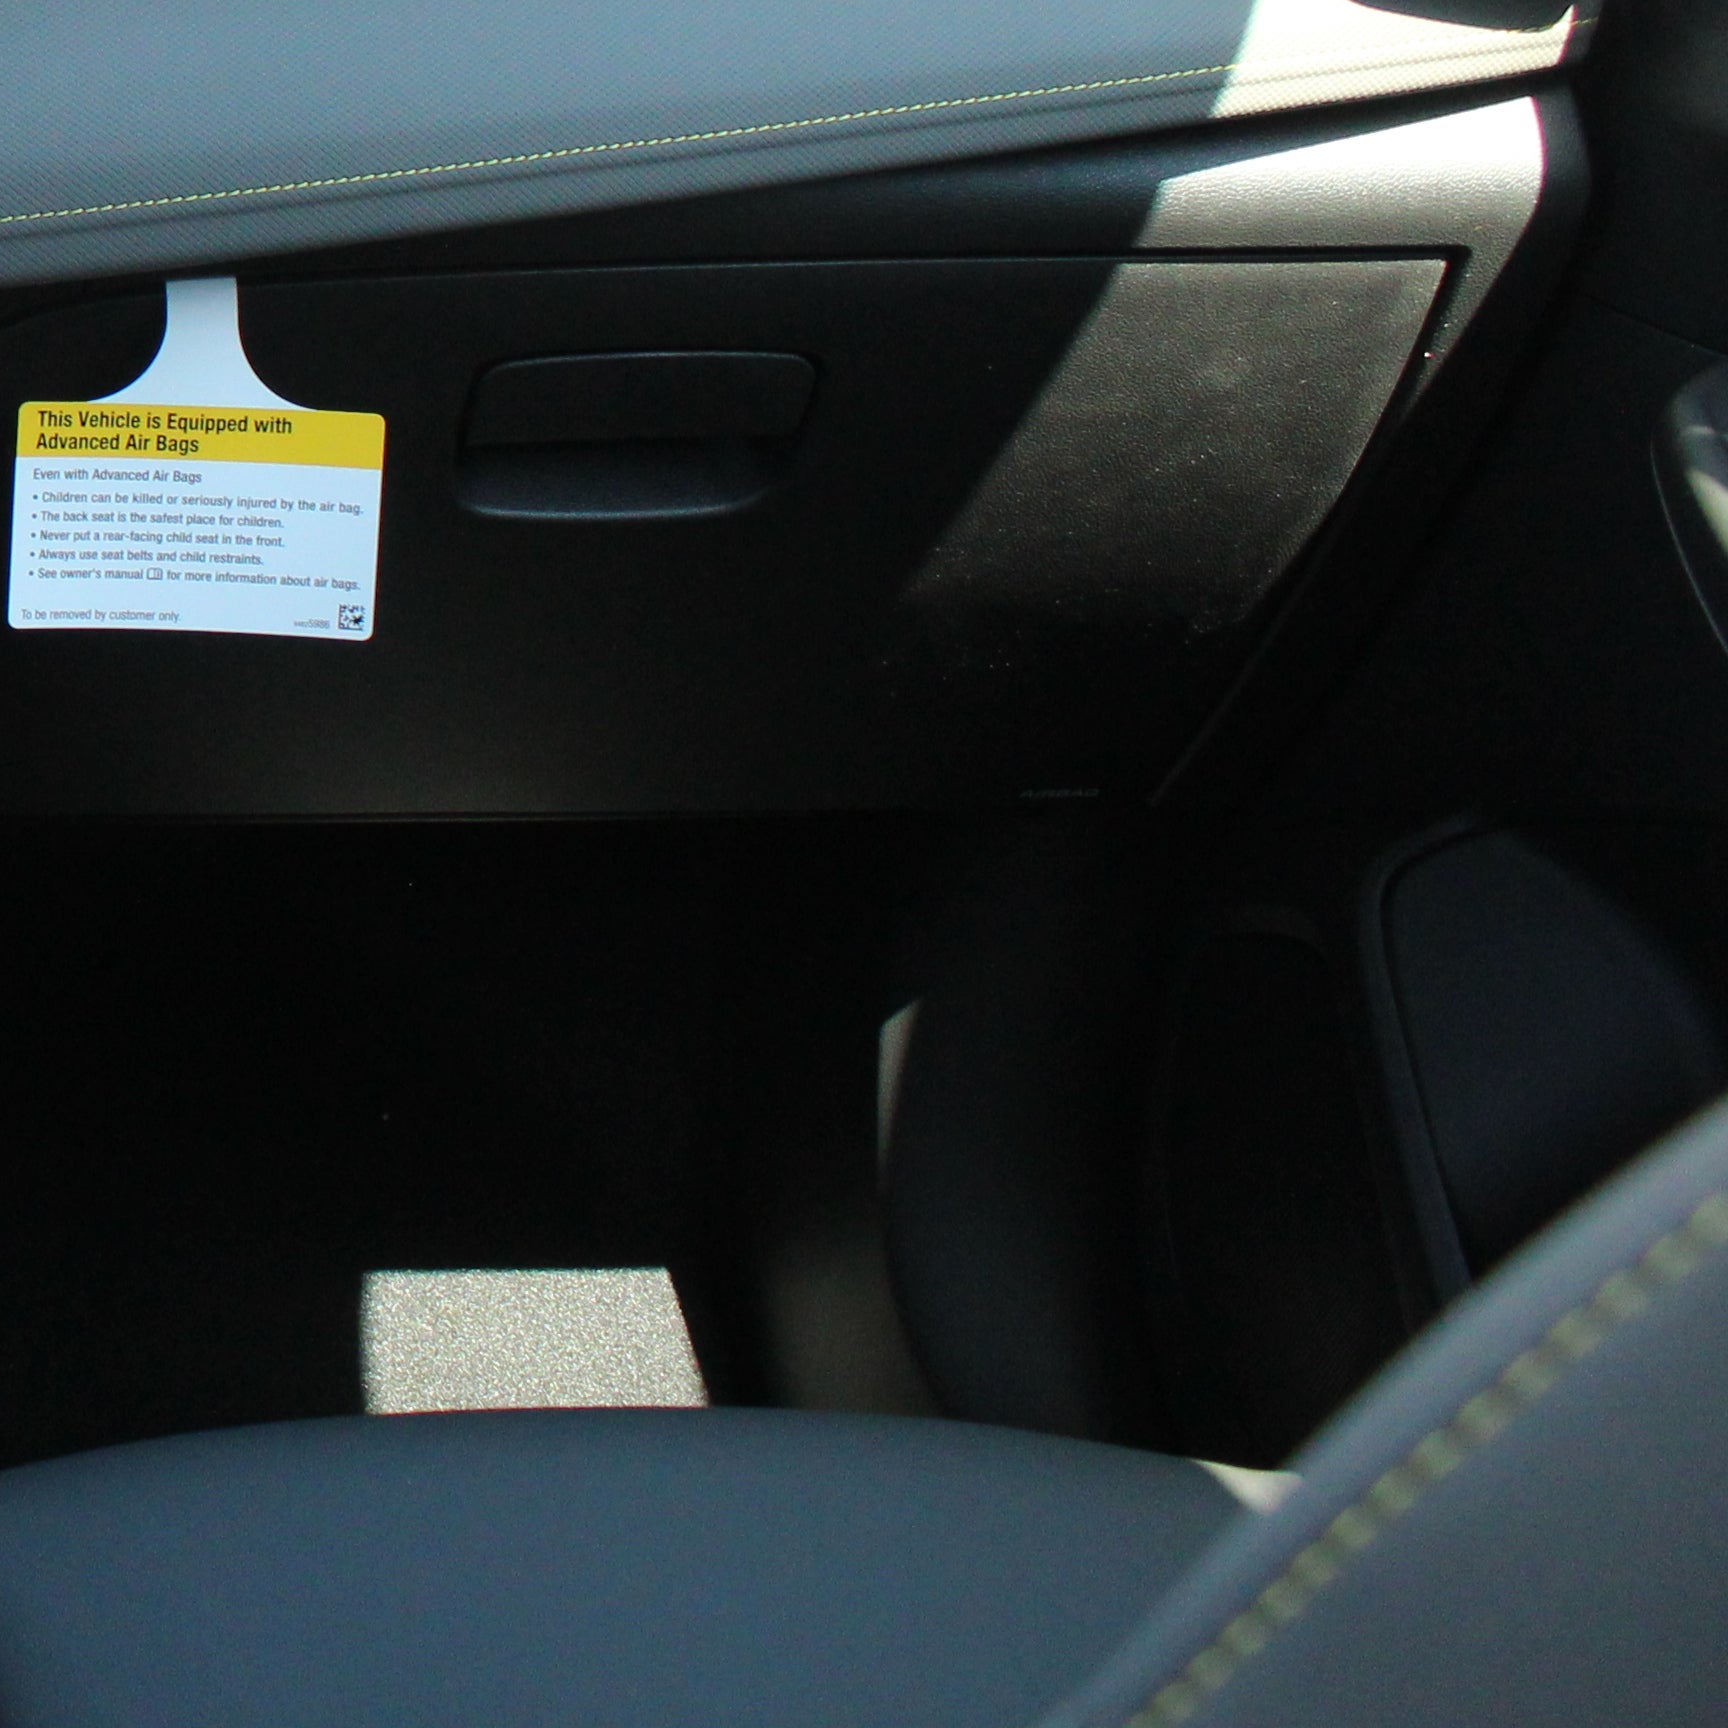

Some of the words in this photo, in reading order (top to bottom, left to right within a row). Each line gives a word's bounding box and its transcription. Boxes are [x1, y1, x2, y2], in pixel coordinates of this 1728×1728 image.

[38, 411, 73, 427] This
[79, 411, 140, 428] Vehicle
[147, 413, 161, 429] is
[167, 413, 248, 434] Equipped
[254, 417, 292, 434] with
[36, 433, 120, 450] Advanced
[126, 434, 150, 450] Air
[156, 435, 199, 455] Bags
[33, 468, 60, 480] Even
[65, 469, 89, 480] with
[92, 469, 149, 481] Advanced
[153, 470, 169, 481] Air
[173, 471, 202, 485] Bags
[42, 492, 87, 503] Children
[91, 495, 110, 503] can
[115, 493, 128, 503] be
[133, 493, 163, 504] killed
[167, 496, 177, 504] or
[182, 496, 233, 509] seriously
[237, 497, 277, 509] injured
[280, 499, 294, 511] by
[298, 499, 316, 511] the
[320, 502, 335, 511] air
[339, 502, 364, 516] bag.
[41, 511, 60, 521] The
[63, 512, 87, 521] back
[92, 513, 114, 522] seat
[118, 512, 126, 522] is
[131, 513, 147, 522] the
[150, 513, 183, 524] safest
[186, 514, 215, 526] place
[219, 516, 234, 526] for
[237, 517, 284, 528] children.
[40, 530, 70, 540] Never
[73, 532, 91, 541] put
[103, 532, 163, 544] rear-facing
[166, 532, 192, 542] child
[196, 534, 219, 544] seat
[222, 534, 231, 544] in
[235, 535, 252, 545] the
[256, 535, 285, 547] front.
[39, 549, 75, 561] Always
[101, 551, 123, 560] seat
[127, 551, 153, 560] belts
[157, 552, 176, 561] and
[180, 553, 206, 562] child
[209, 553, 264, 565] restraints.
[38, 568, 56, 578] See
[60, 569, 101, 579] owner's
[105, 569, 143, 579] manual
[167, 570, 181, 580] for
[184, 572, 211, 582] more
[215, 572, 276, 585] information
[280, 575, 310, 587] about
[314, 578, 328, 587] air
[332, 578, 360, 592] bags.
[21, 609, 32, 619] To
[35, 610, 46, 620] be
[50, 610, 91, 620] removed
[94, 610, 105, 621] by
[109, 611, 155, 621] customer
[159, 612, 180, 622] only.
